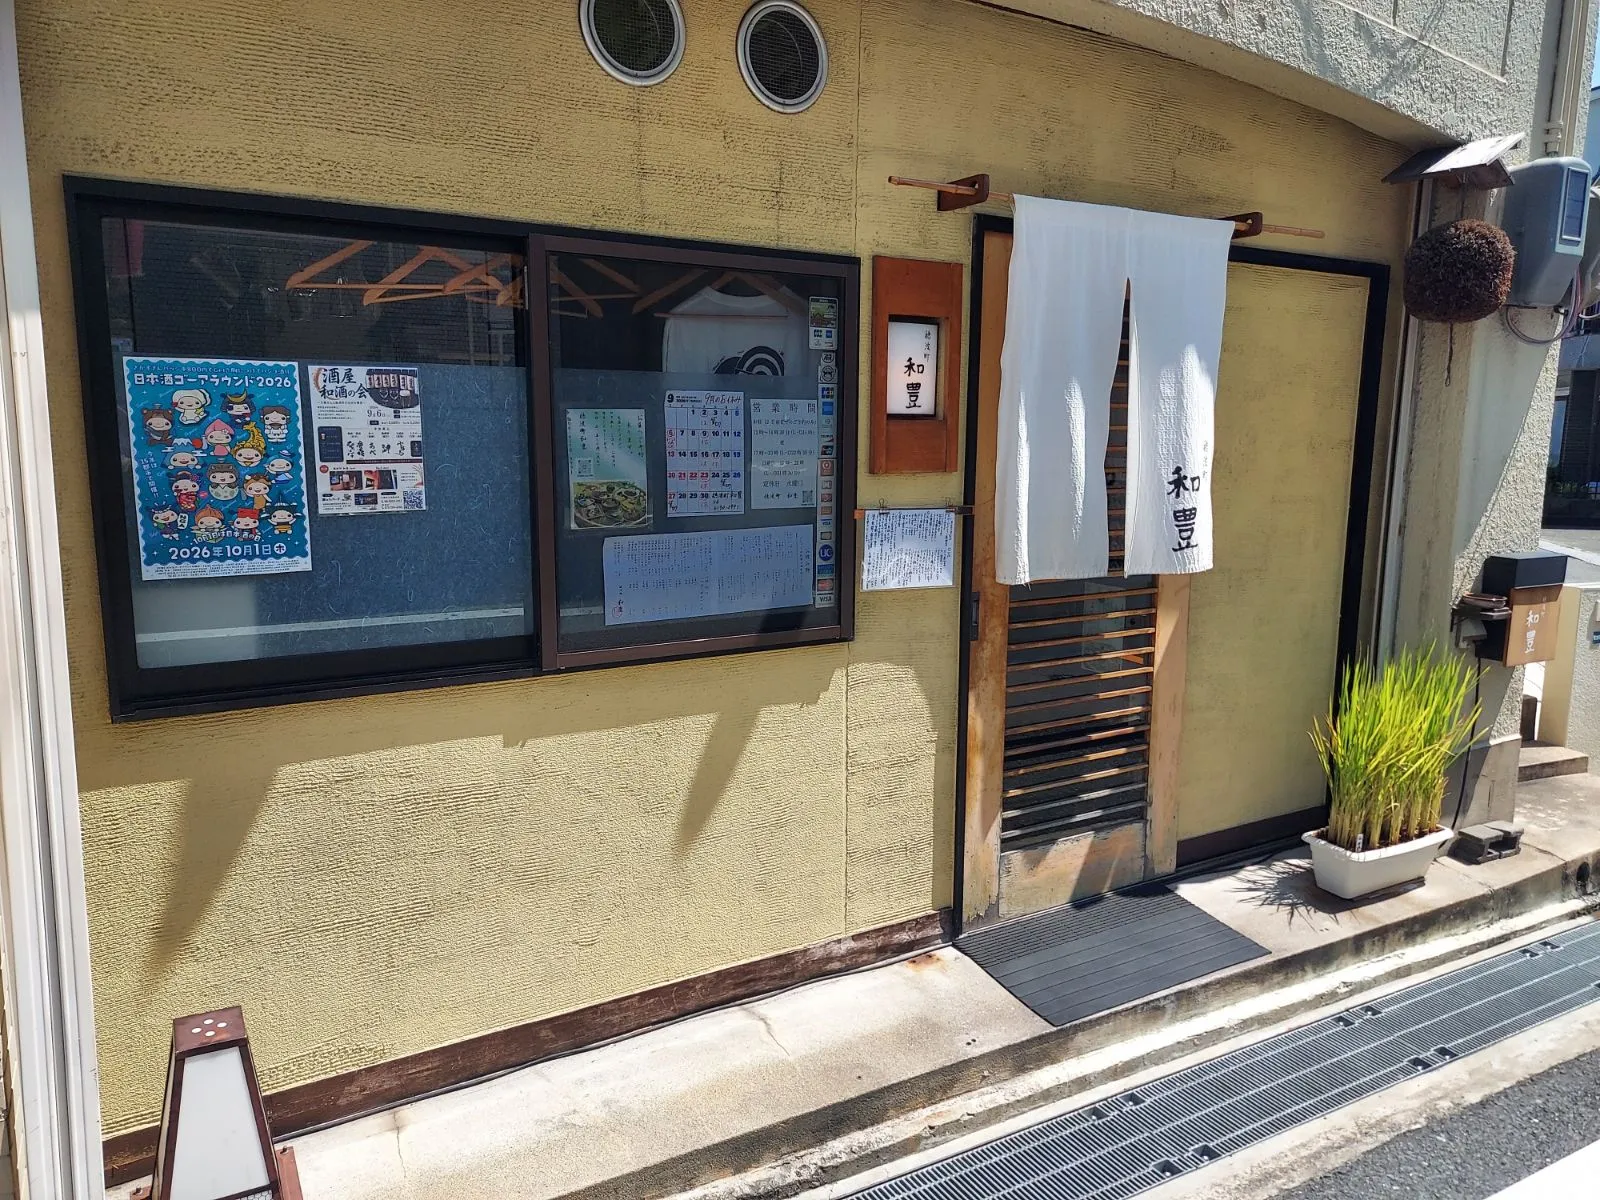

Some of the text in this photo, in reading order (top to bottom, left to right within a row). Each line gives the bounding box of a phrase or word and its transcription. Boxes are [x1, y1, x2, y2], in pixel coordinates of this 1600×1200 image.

[134, 373, 292, 388] 日本酒ゴーアラウンド2026
[323, 368, 356, 384] 酒屋
[904, 356, 924, 409] 和豊
[320, 383, 369, 399] 和酒の会
[667, 394, 674, 402] 9
[753, 402, 816, 414] 営業時間
[1166, 466, 1200, 552] 和豊
[169, 544, 272, 560] 2026年10月1日
[820, 549, 832, 557] UC
[1525, 610, 1540, 654] 和豊
